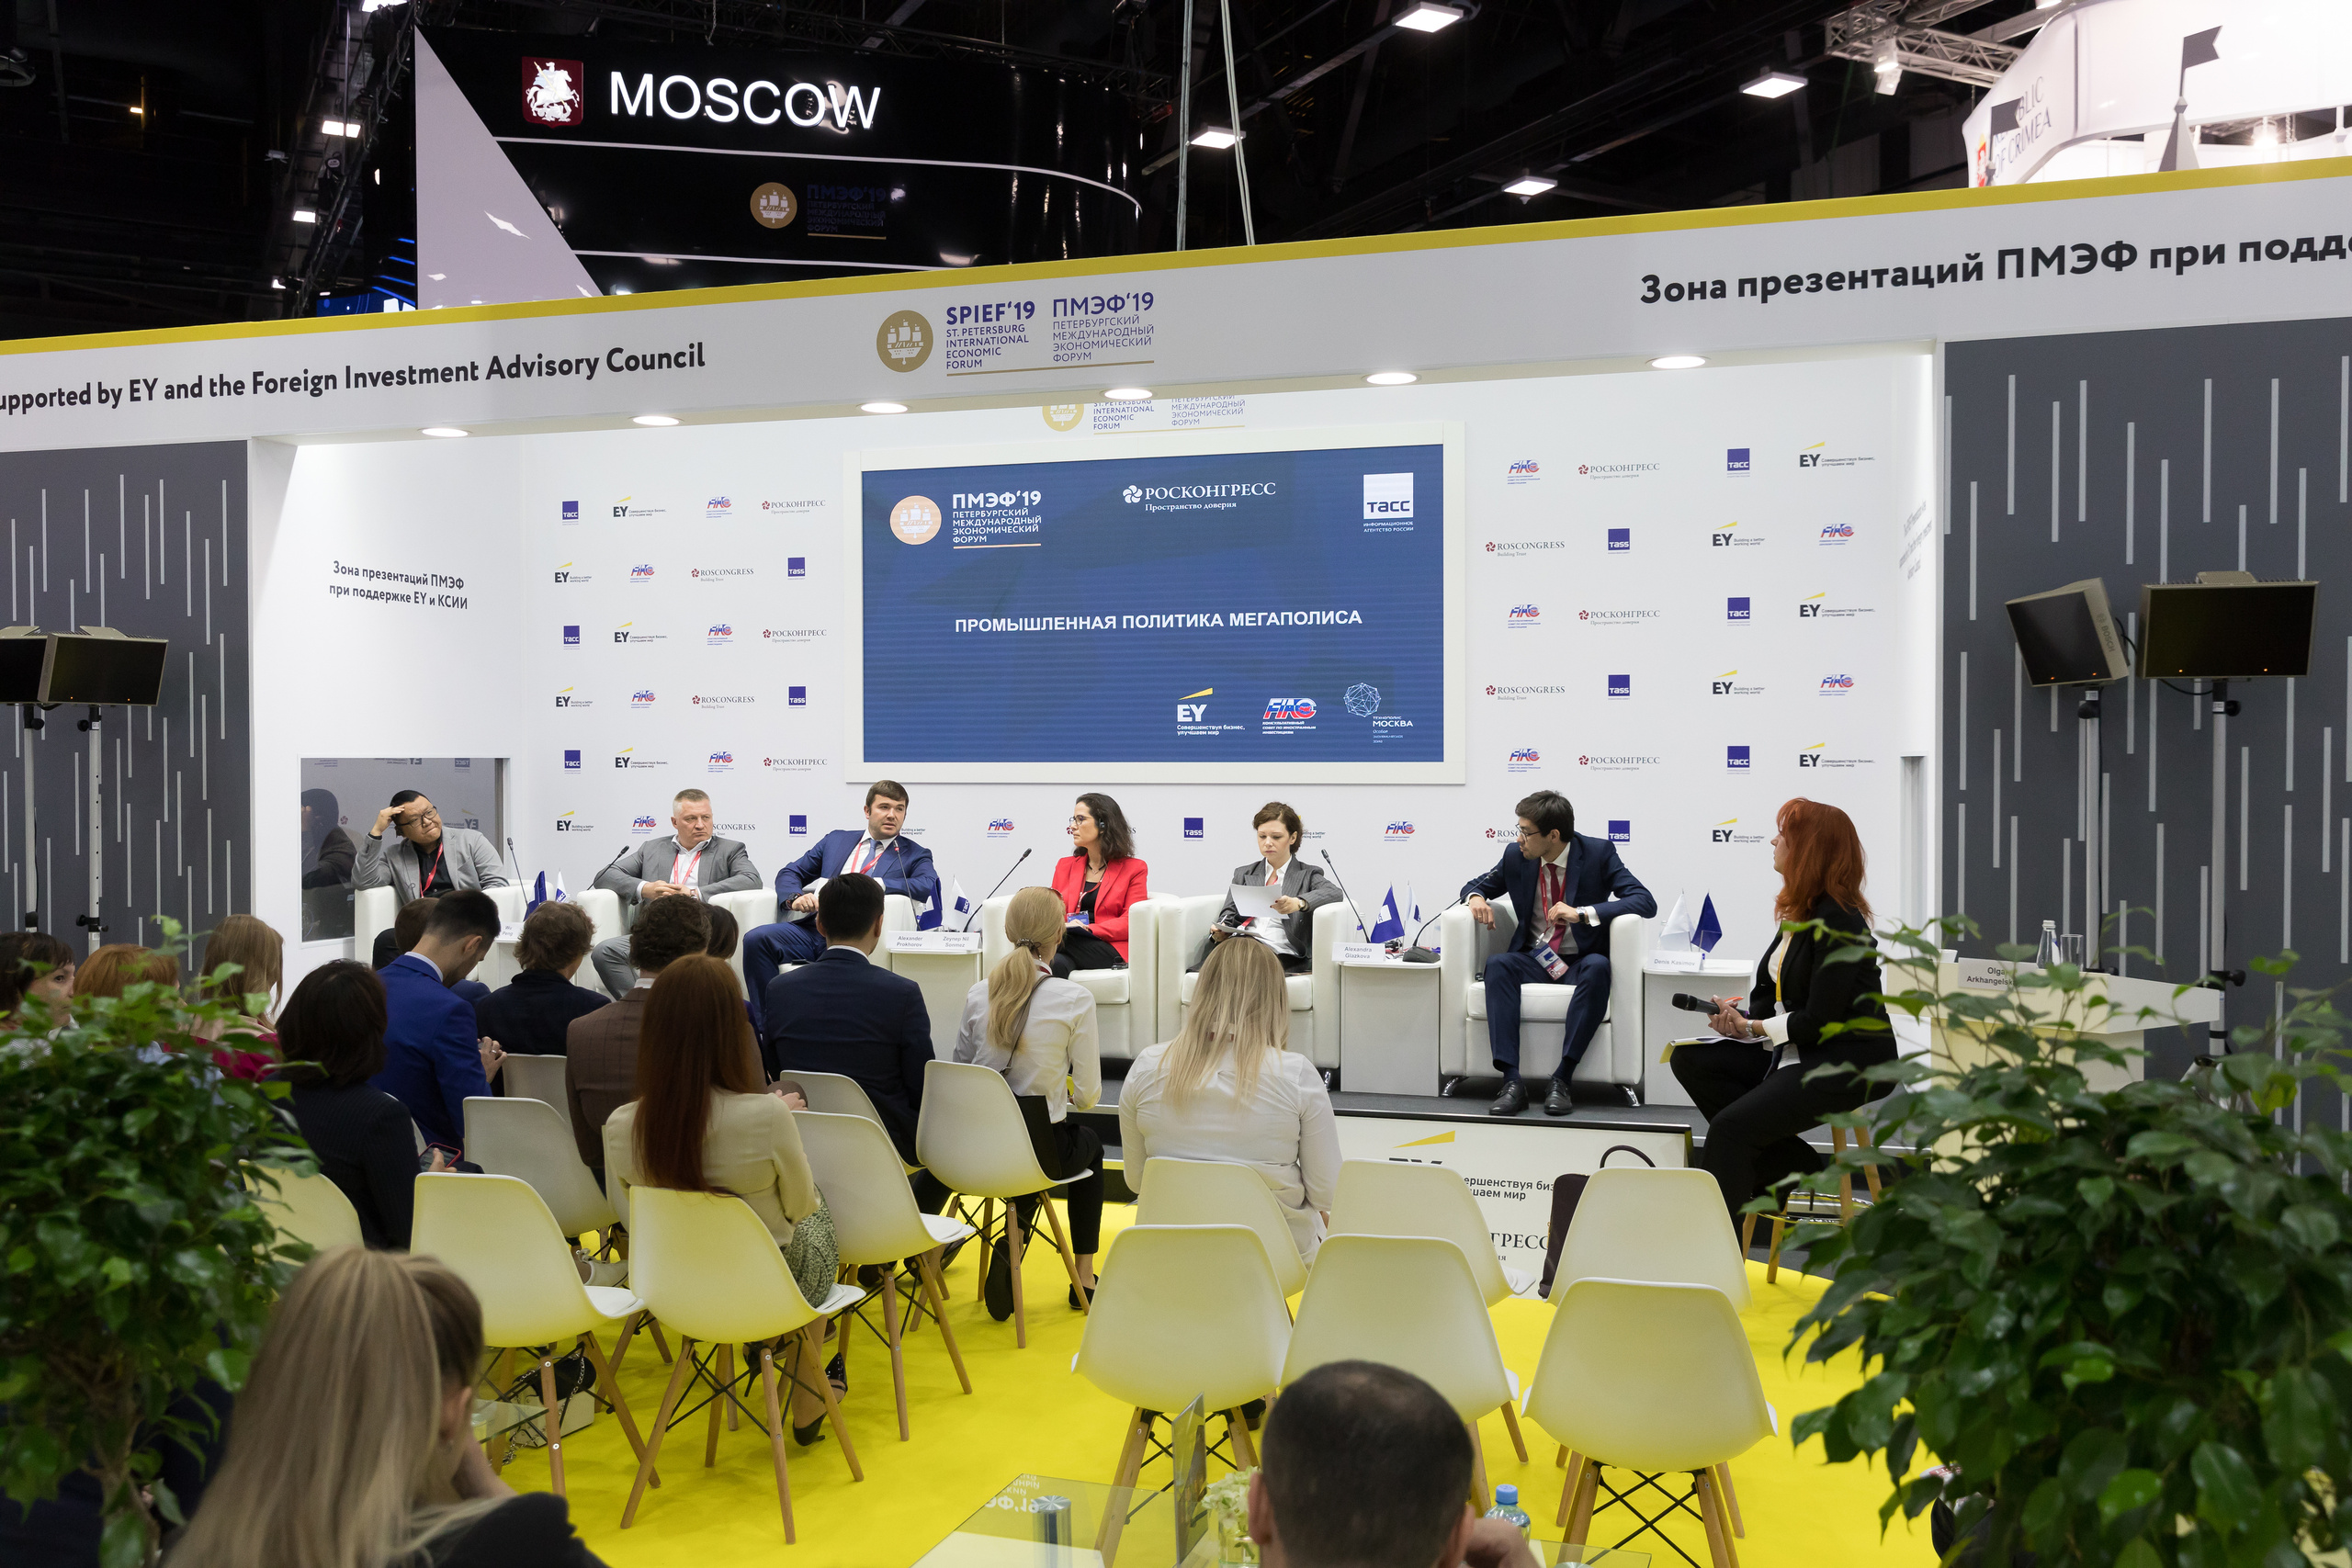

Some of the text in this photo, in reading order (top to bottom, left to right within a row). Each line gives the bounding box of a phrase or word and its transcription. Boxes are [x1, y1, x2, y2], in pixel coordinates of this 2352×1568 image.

[609, 71, 882, 130] MOSCOW
[2007, 106, 2052, 164] CRIMEA
[807, 201, 875, 210] ПЕТЕРБУРГСКИЙ
[807, 209, 887, 220] МЕЖДУНАРОДНЫЙ
[807, 216, 884, 227] ЭКОНОМИЧЕСКИЙ
[807, 224, 838, 232] ФОРУМ
[1639, 234, 2352, 305] Зона презентаций ПМЭФ при подд
[1053, 313, 1140, 330] ПЕТЕРБУРГСКИЙ
[946, 323, 1025, 338] ST. PETERSBURG
[1053, 323, 1155, 341] МЕЖДУНАРОДНЫЙ
[946, 334, 1030, 348] INTERNATIONAL
[1053, 335, 1152, 352] ЭКОНОМИЧЕСКИЙ
[946, 346, 1001, 359] ECONOMIC
[1053, 351, 1091, 363] ФОРУМ
[946, 358, 983, 369] FORUM
[0, 341, 707, 415] upported by EY and the Foreign Investment Advisory Council
[1093, 404, 1155, 414] INTERNATIONAL
[1171, 400, 1246, 411] МЕЖДУНАРОДНЫЙ
[1093, 413, 1135, 423] ECONOMIC
[1171, 407, 1244, 419] ЭКОНОМИЧЕСКИЙ
[1171, 418, 1200, 426] ФОРУМ
[1799, 454, 1821, 468] EY
[1590, 463, 1660, 473] РОСКОНГРЕСС
[1144, 481, 1277, 500] РОСКОНГРЕСС
[771, 500, 826, 509] РОСКОНГРЕСС
[1144, 499, 1238, 513] Пространство доверия
[613, 505, 628, 518] EY
[952, 507, 1029, 519] ПЕТЕРБУРГСКИЙ
[952, 515, 1042, 527] МЕЖДУНАРОДНЫЙ
[952, 524, 1039, 536] ЭКОНОМИЧЕСКИЙ
[952, 536, 987, 544] ФОРУМ
[1497, 541, 1566, 550] ROSCONGRESS
[1713, 533, 1733, 547] EY
[333, 560, 464, 590] Зона презентаций ПМЭФ
[554, 571, 570, 583] EY
[700, 568, 754, 577] ROSCONGRESS
[329, 585, 468, 610] при поддержке EY и КСИИ
[1590, 610, 1660, 619] РОСКОНГРЕСС
[1800, 604, 1821, 617] EY
[955, 609, 1363, 633] ПРОМЫШЛЕННАЯ ПОЛИТИКА МЕГАПОЛИСА
[615, 631, 629, 643] EY
[772, 629, 827, 637] РОСКОНГРЕСС
[1498, 685, 1566, 694] ROSCONGRESS
[1713, 682, 1734, 694] EY
[556, 696, 571, 707] EY
[701, 695, 755, 704] ROSCONGRESS
[1177, 704, 1207, 722] EY
[1262, 697, 1317, 720] FIAC
[615, 757, 630, 768] EY
[773, 758, 828, 766] РОСКОНГРЕСС
[1590, 756, 1660, 764] РОСКОНГРЕСС
[1799, 754, 1821, 767] EY
[557, 820, 571, 831] EY
[713, 823, 756, 831] SCONGRESS
[1713, 829, 1733, 842] EY
[1987, 966, 2006, 976] Olga
[1966, 976, 2014, 986] Arkhangelsk
[1464, 1177, 1532, 1190] ершенствуя
[1504, 1190, 1526, 1201] мир
